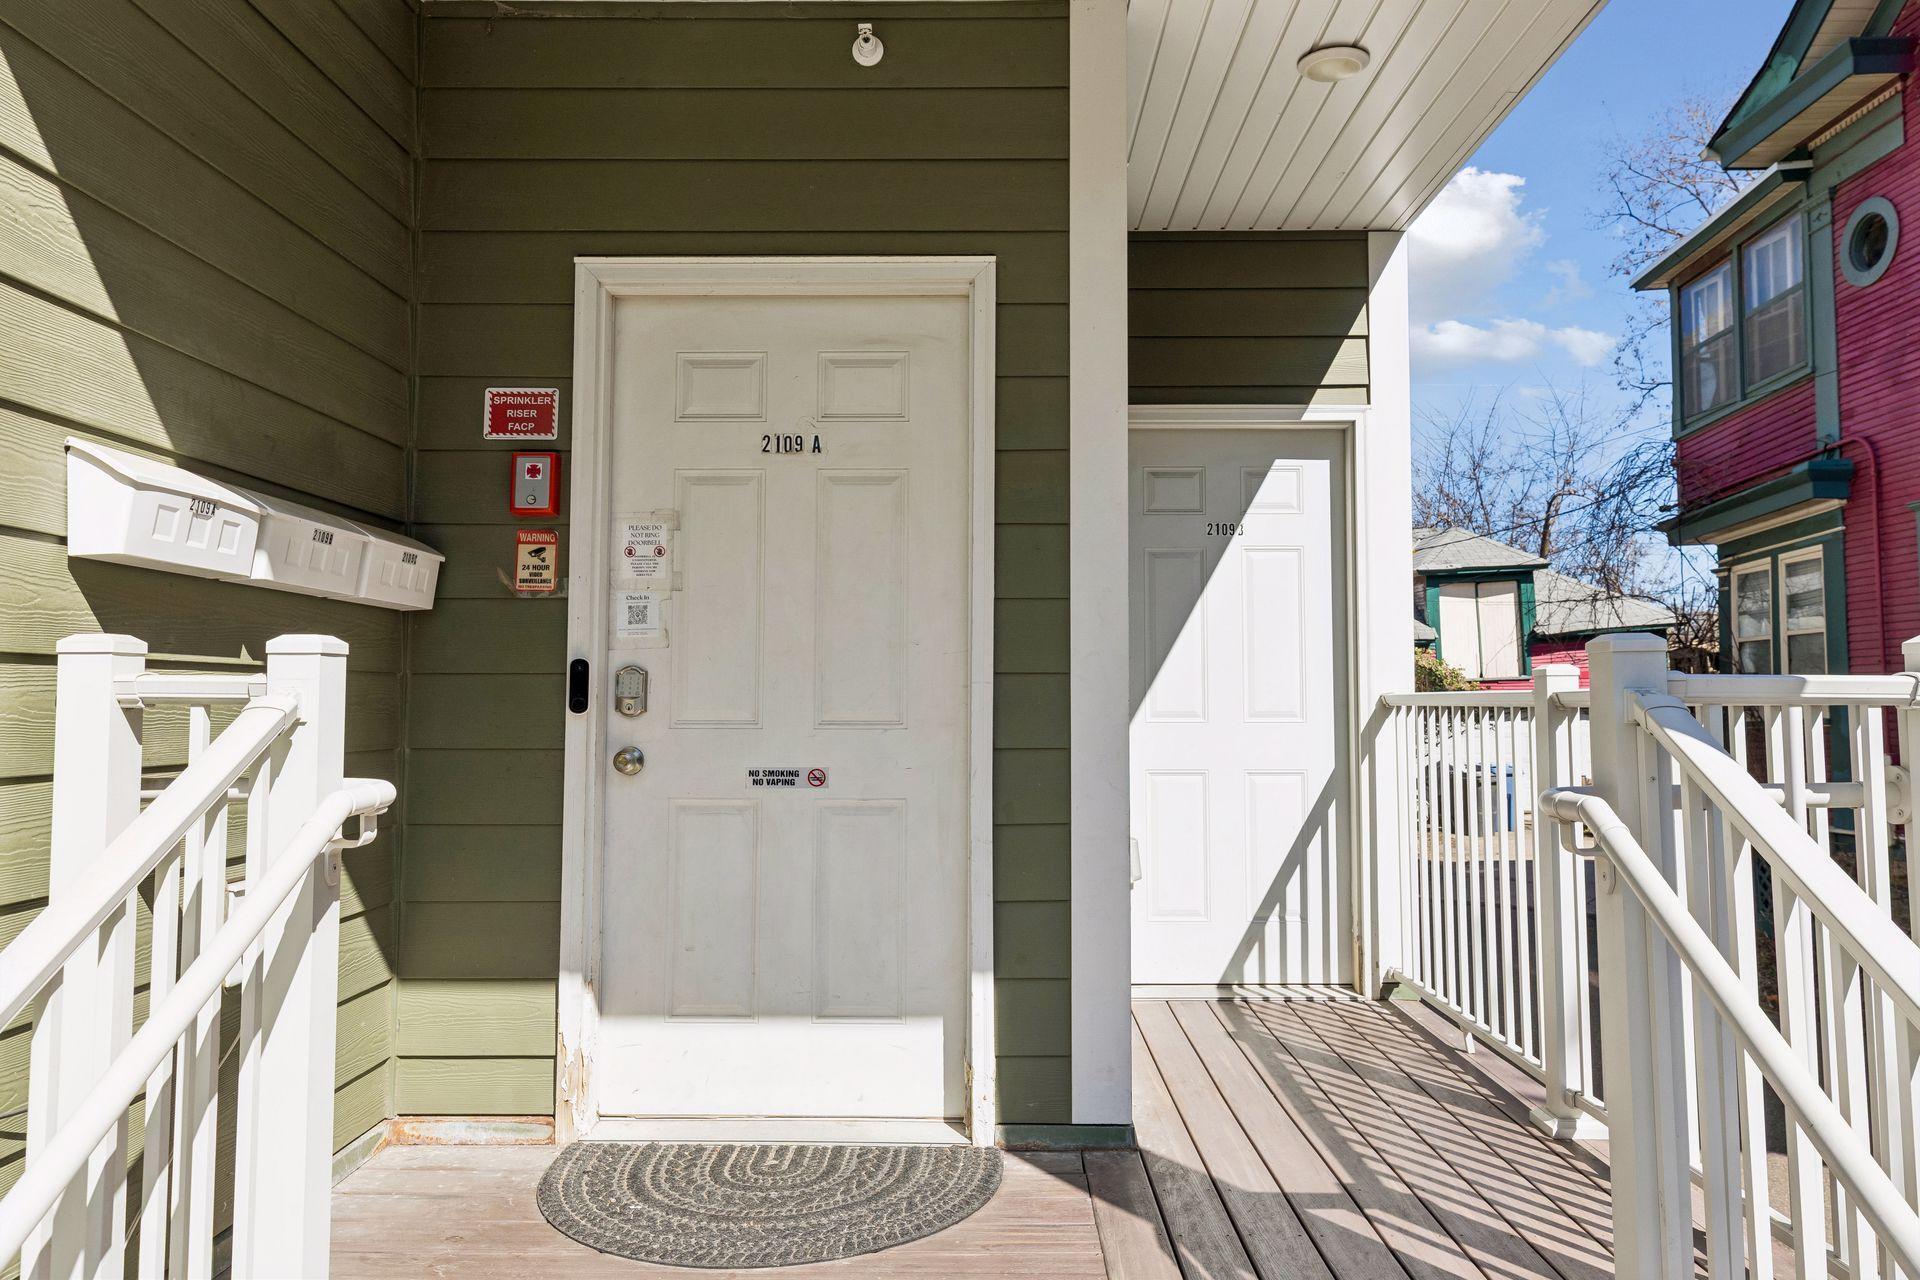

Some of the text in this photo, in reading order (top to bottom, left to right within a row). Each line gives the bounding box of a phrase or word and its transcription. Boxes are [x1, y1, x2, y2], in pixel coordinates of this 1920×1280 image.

[493, 396, 552, 405] SPRINKLER
[506, 409, 538, 418] RISER
[508, 422, 535, 431] FACP
[761, 434, 822, 453] 2109 A
[189, 498, 217, 516] 2109A
[519, 532, 556, 542] WARNING
[748, 769, 800, 778] NO SMOKING
[752, 778, 796, 786] NO VAPING
